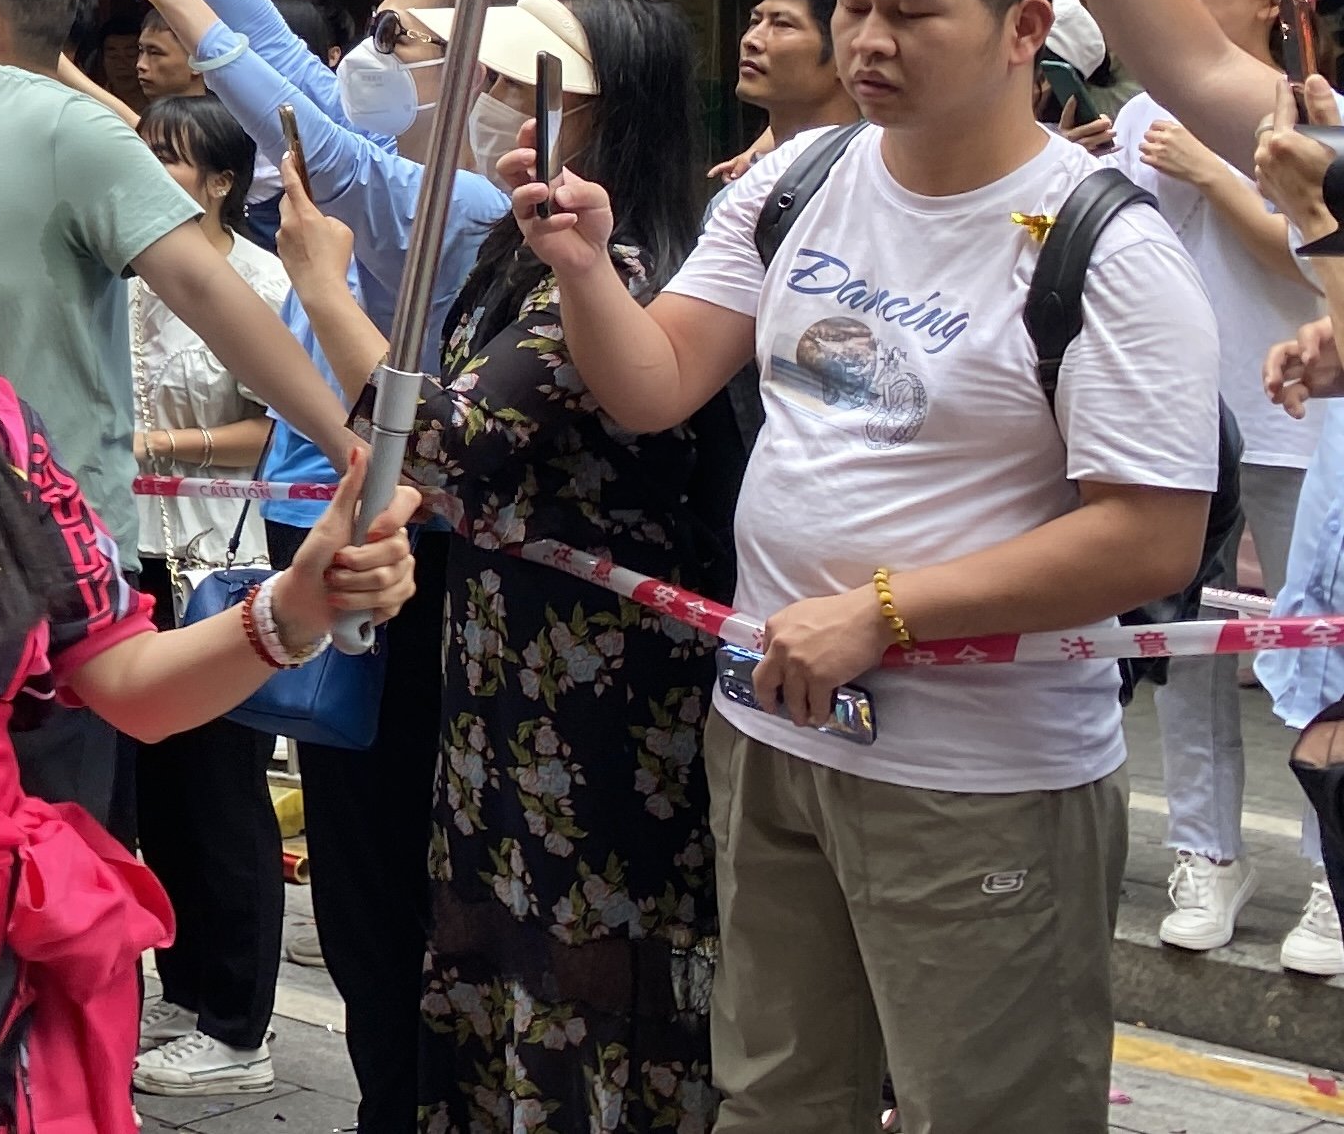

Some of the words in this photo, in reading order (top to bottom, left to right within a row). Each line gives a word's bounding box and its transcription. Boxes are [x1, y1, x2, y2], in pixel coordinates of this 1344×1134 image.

[787, 248, 970, 354] Dancing
[1060, 632, 1170, 661] 注意
[1242, 619, 1342, 650] 安全
